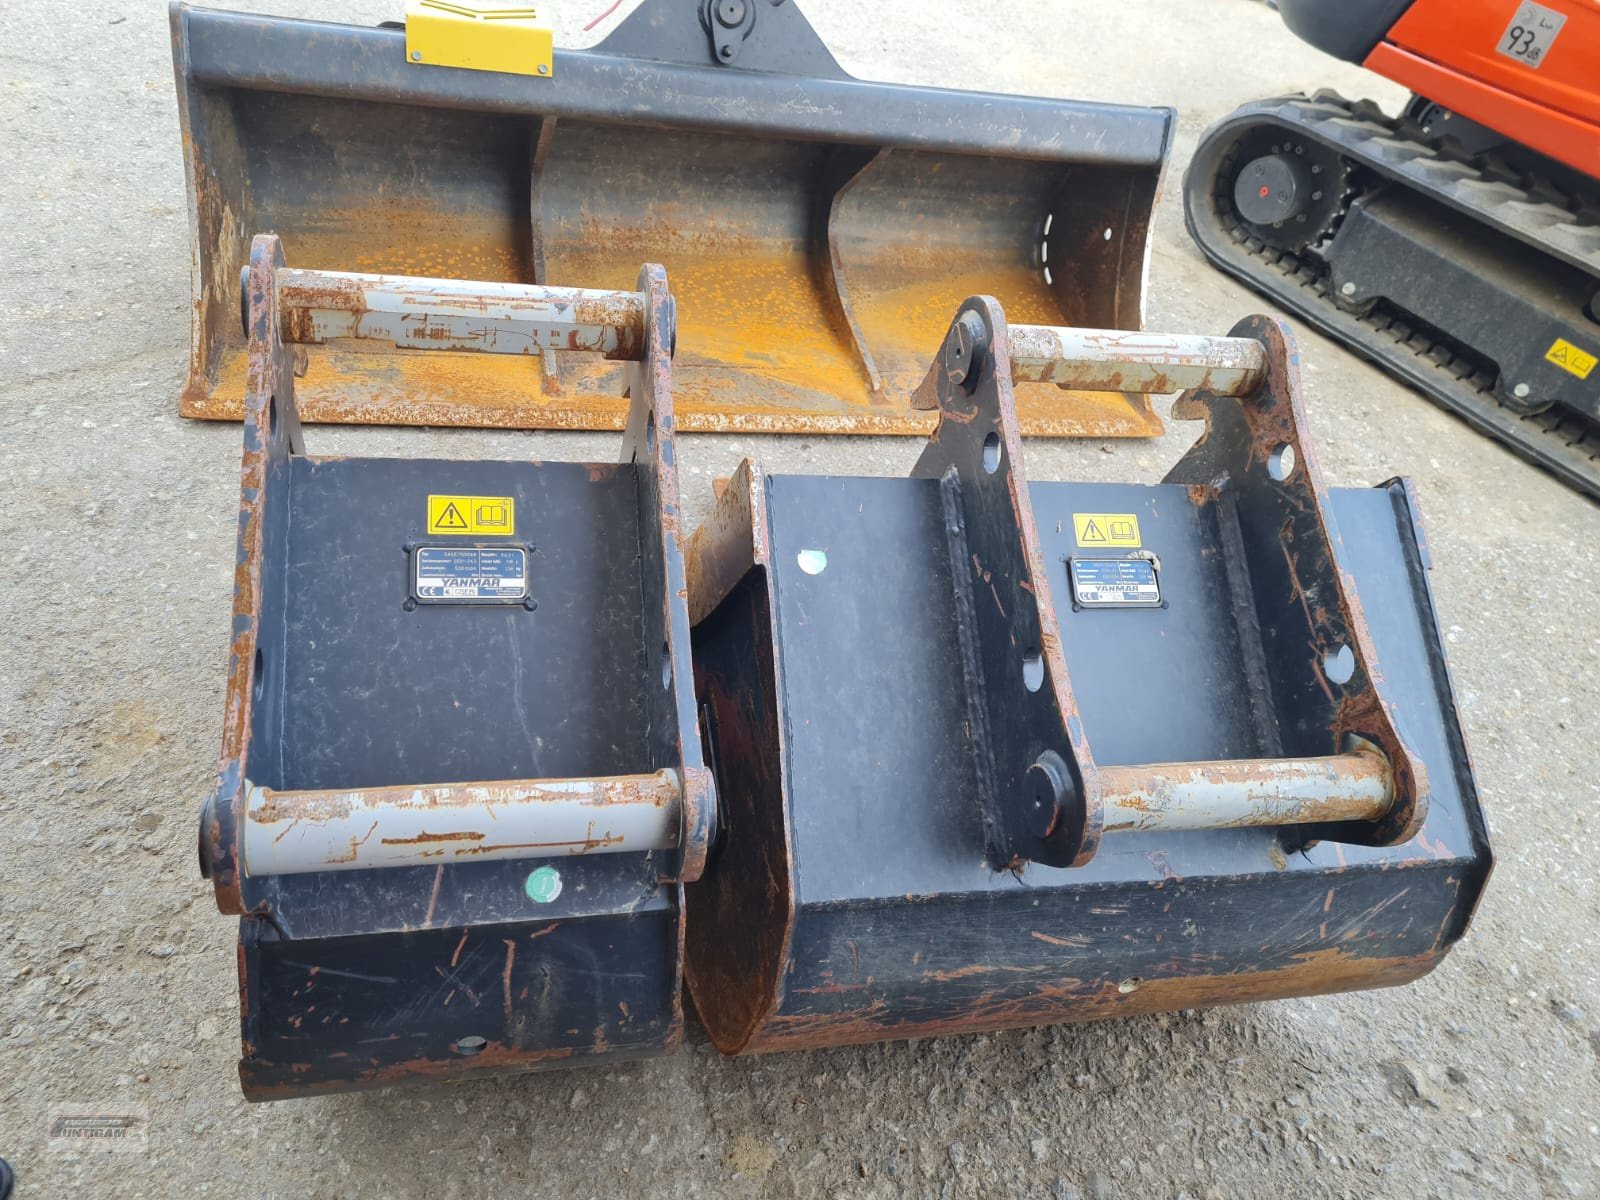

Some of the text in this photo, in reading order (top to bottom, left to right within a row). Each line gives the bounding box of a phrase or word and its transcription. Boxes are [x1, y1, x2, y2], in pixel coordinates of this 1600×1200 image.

[1507, 25, 1536, 56] 93
[442, 578, 501, 587] YANMAR
[422, 587, 436, 596] CE
